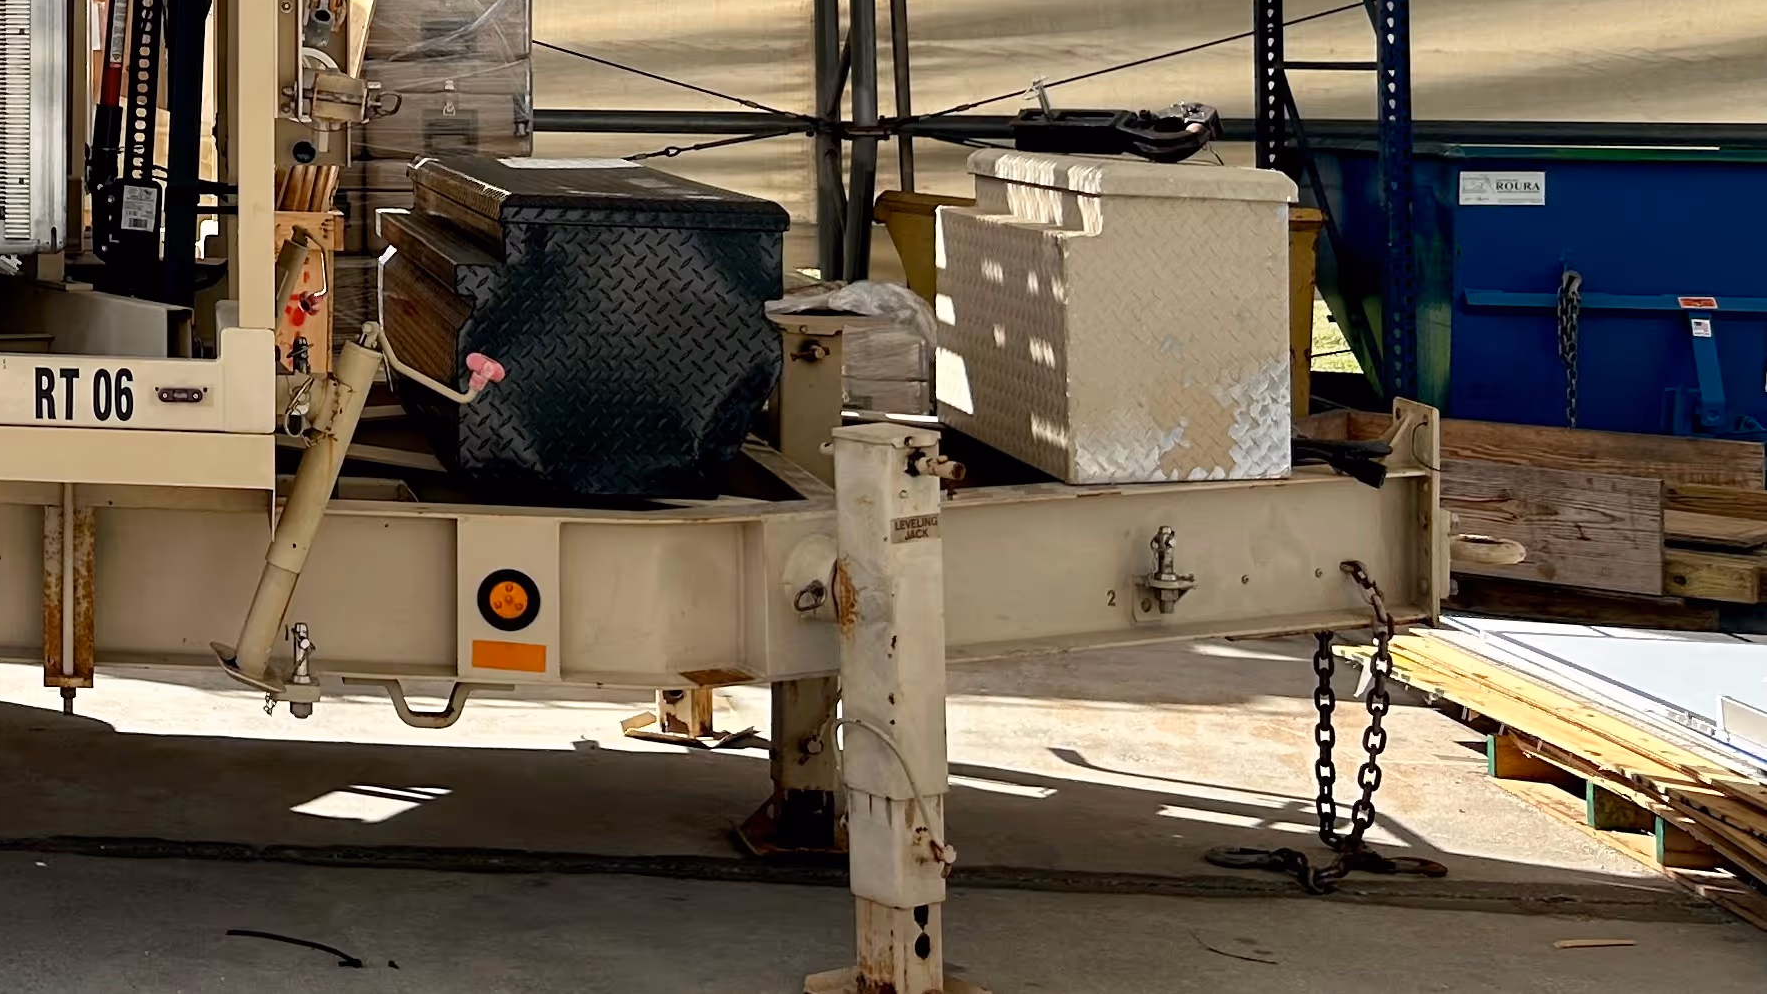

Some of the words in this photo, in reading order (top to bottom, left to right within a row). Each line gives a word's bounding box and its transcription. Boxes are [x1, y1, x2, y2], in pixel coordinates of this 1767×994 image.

[1496, 182, 1540, 190] ROURA
[34, 367, 80, 420] RT
[93, 367, 134, 421] 06
[894, 516, 938, 531] LEVELING
[905, 528, 929, 541] JACK
[1106, 589, 1116, 607] 2
